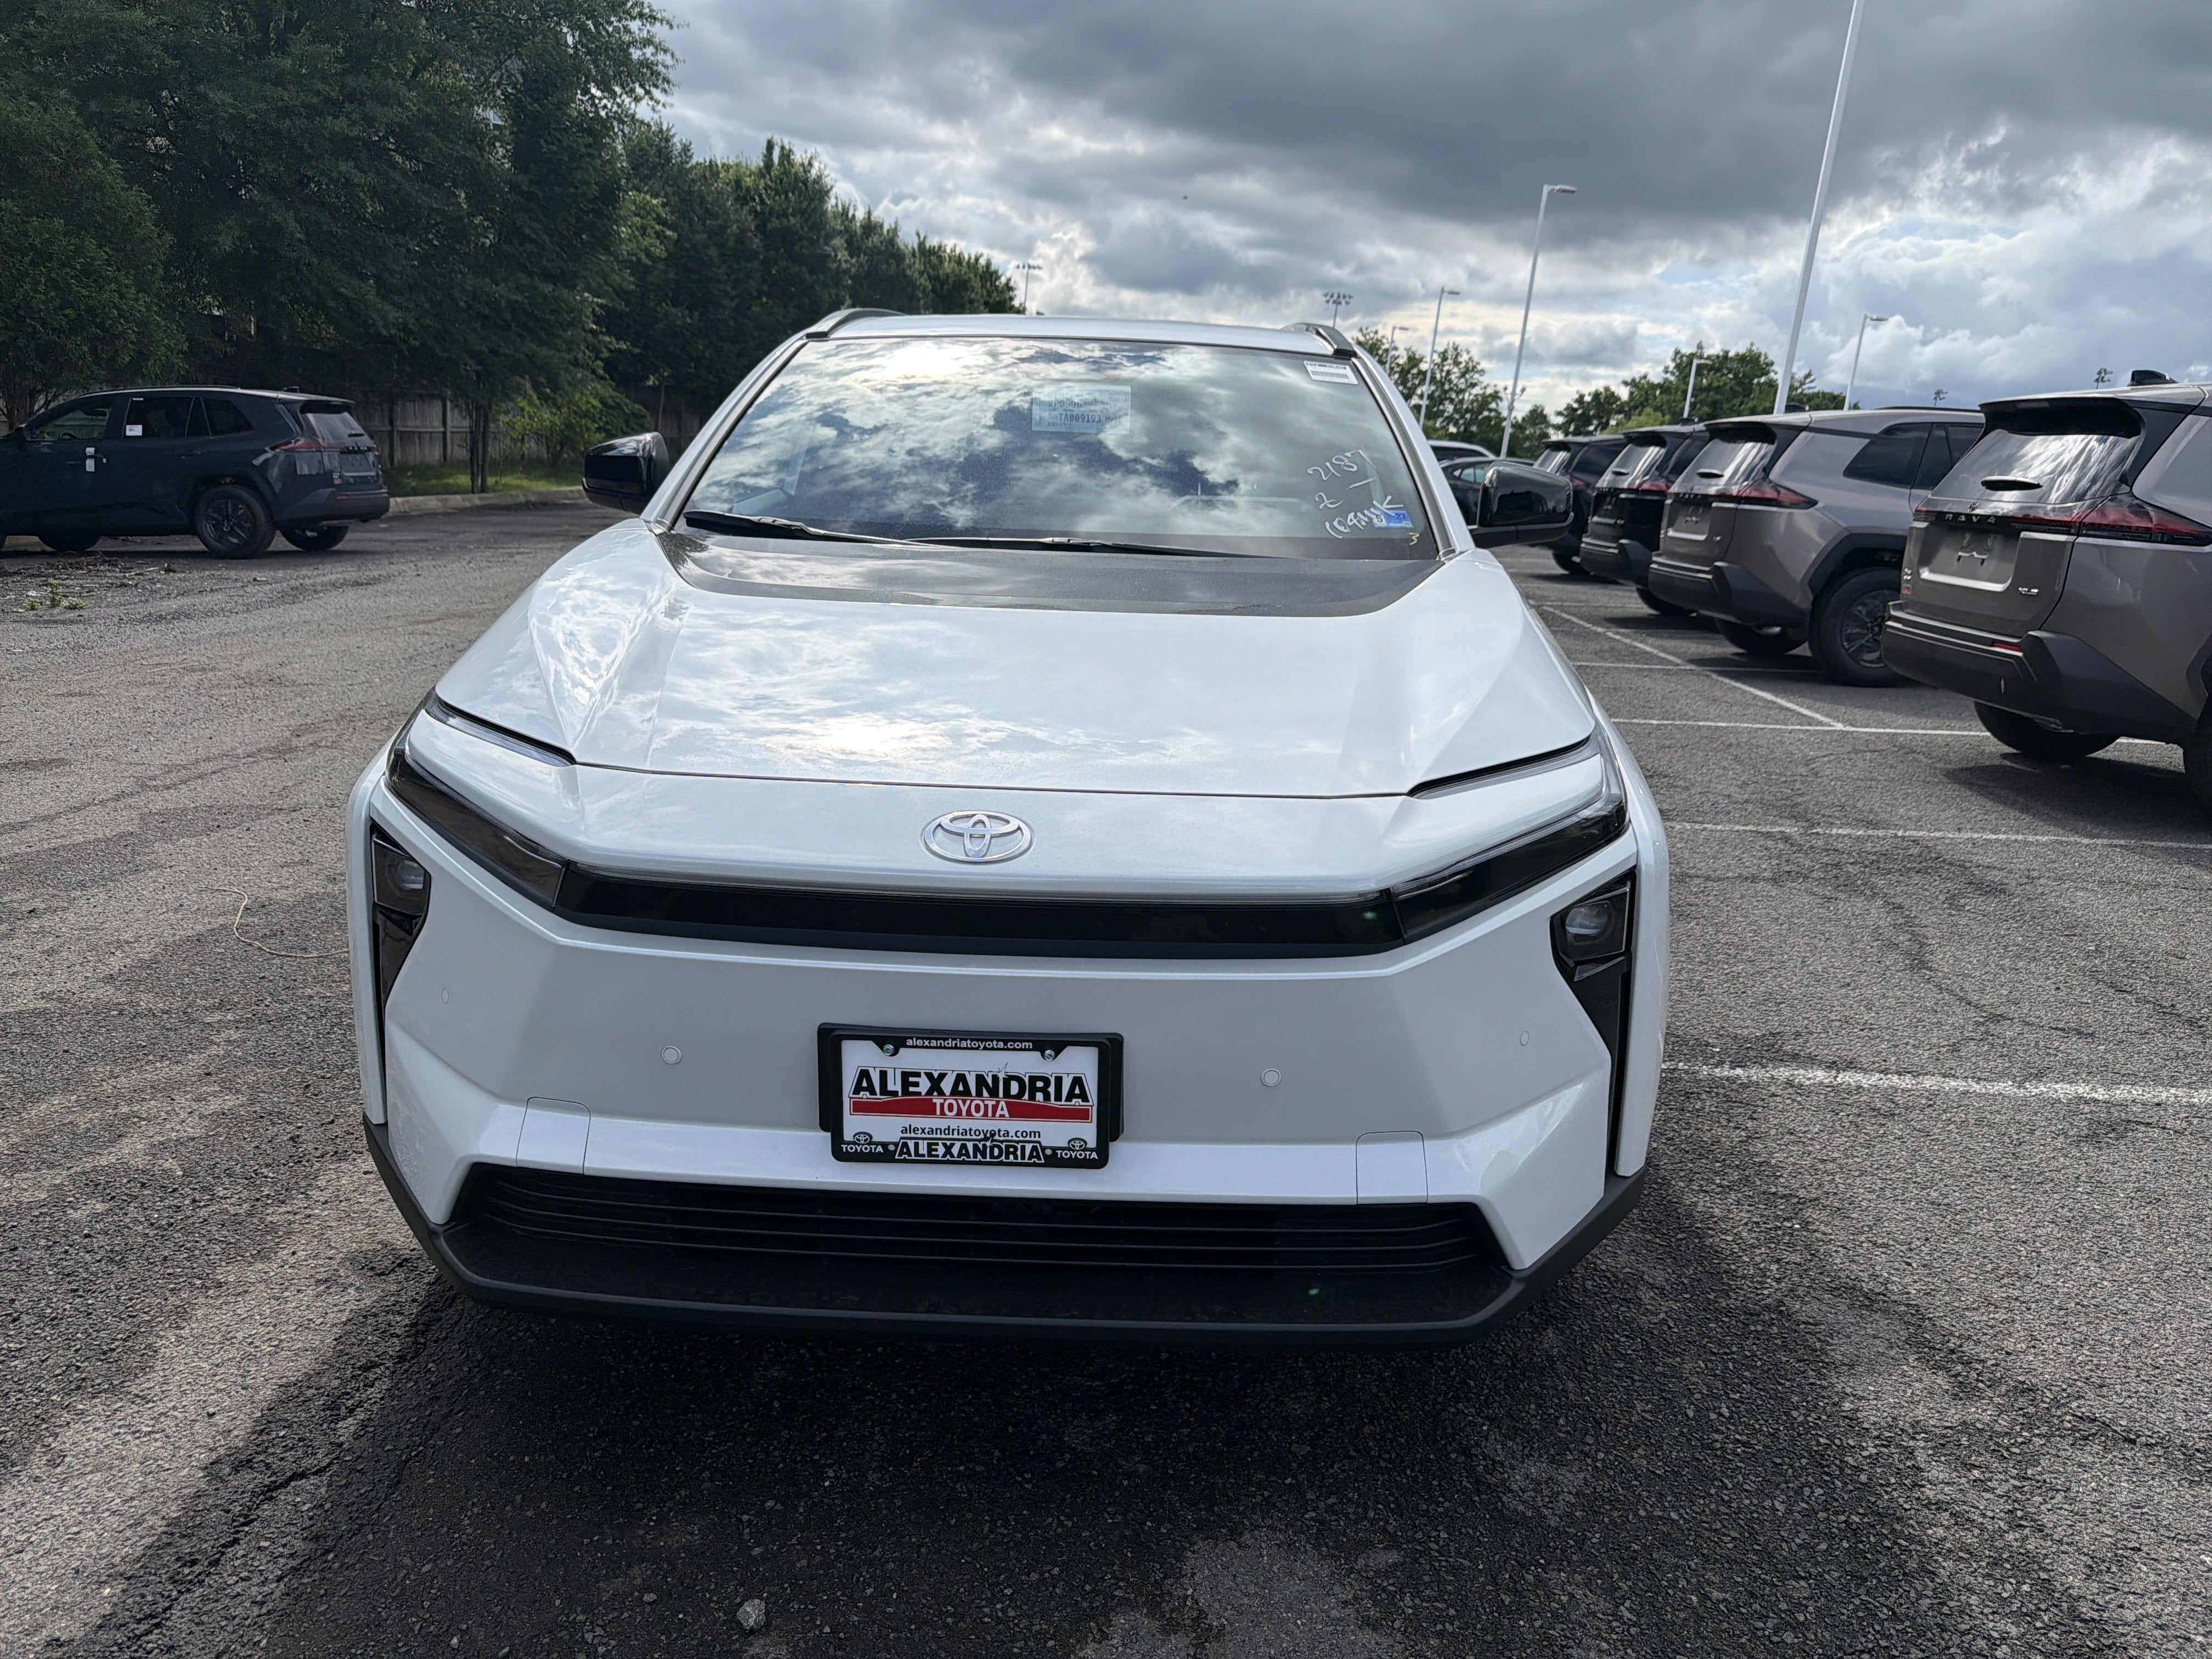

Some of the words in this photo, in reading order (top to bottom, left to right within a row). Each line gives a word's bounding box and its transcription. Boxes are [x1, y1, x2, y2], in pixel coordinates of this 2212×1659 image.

[1058, 413, 1102, 424] TA009193
[1375, 515, 1383, 523] 5
[906, 1037, 1032, 1050] alexandriatoyota.com
[850, 1068, 1092, 1104] ALEXANDRIA
[932, 1098, 1010, 1118] TOYOTA
[900, 1124, 1041, 1139] alexandriatoyota.com
[841, 1144, 884, 1153] TOYOTA
[895, 1139, 1045, 1163] ALEXANDRIA
[1056, 1150, 1098, 1159] TOYOTA
